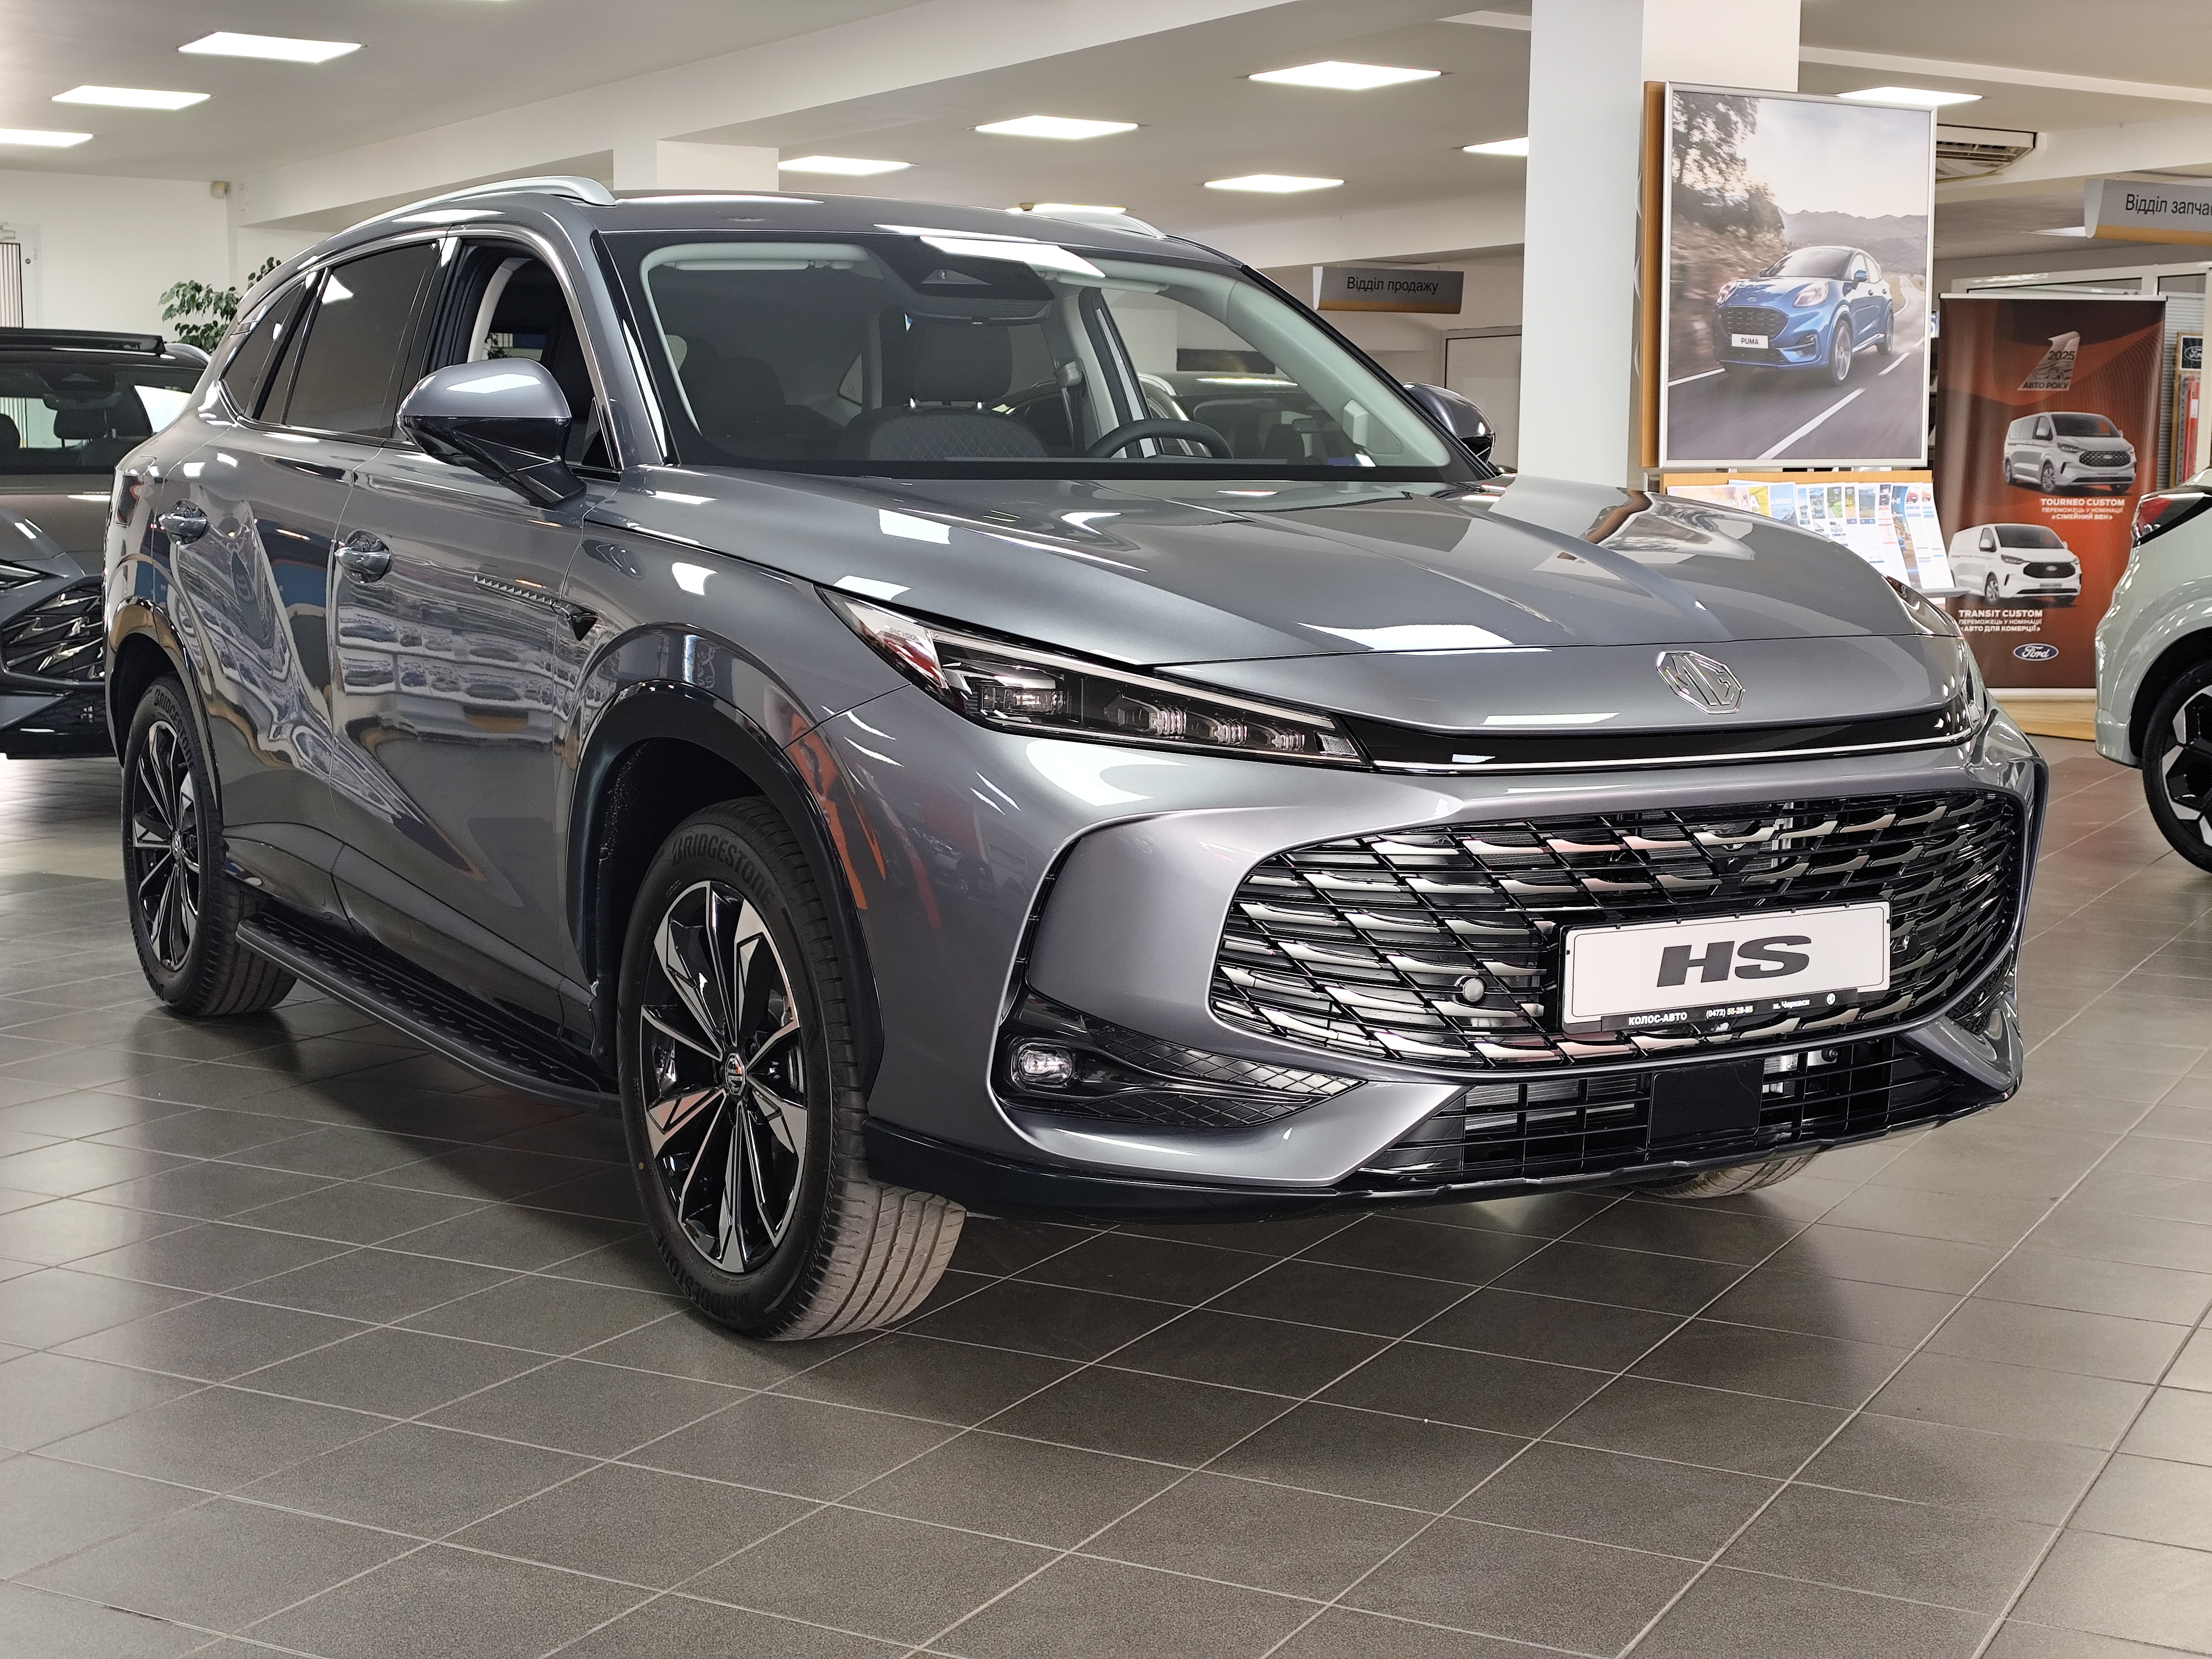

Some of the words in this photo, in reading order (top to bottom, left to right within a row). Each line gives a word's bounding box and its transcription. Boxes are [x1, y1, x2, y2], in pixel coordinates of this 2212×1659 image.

[2125, 194, 2167, 215] Відділ
[1347, 276, 1384, 292] Відділ
[1387, 280, 1439, 294] продажу
[2048, 350, 2076, 360] 2025
[1958, 609, 2001, 618] TRANSIT
[2002, 609, 2043, 618] CUSTOM
[889, 627, 901, 635] SAIC
[2022, 645, 2051, 658] Ford
[1662, 653, 1737, 708] MG
[671, 833, 776, 910] BRIDGESTONE
[1657, 935, 1811, 987] HS
[1628, 1011, 1688, 1026] КОЛОС-АВТО
[1706, 1008, 1726, 1019] (0472)
[1781, 999, 1810, 1009] Черкаси
